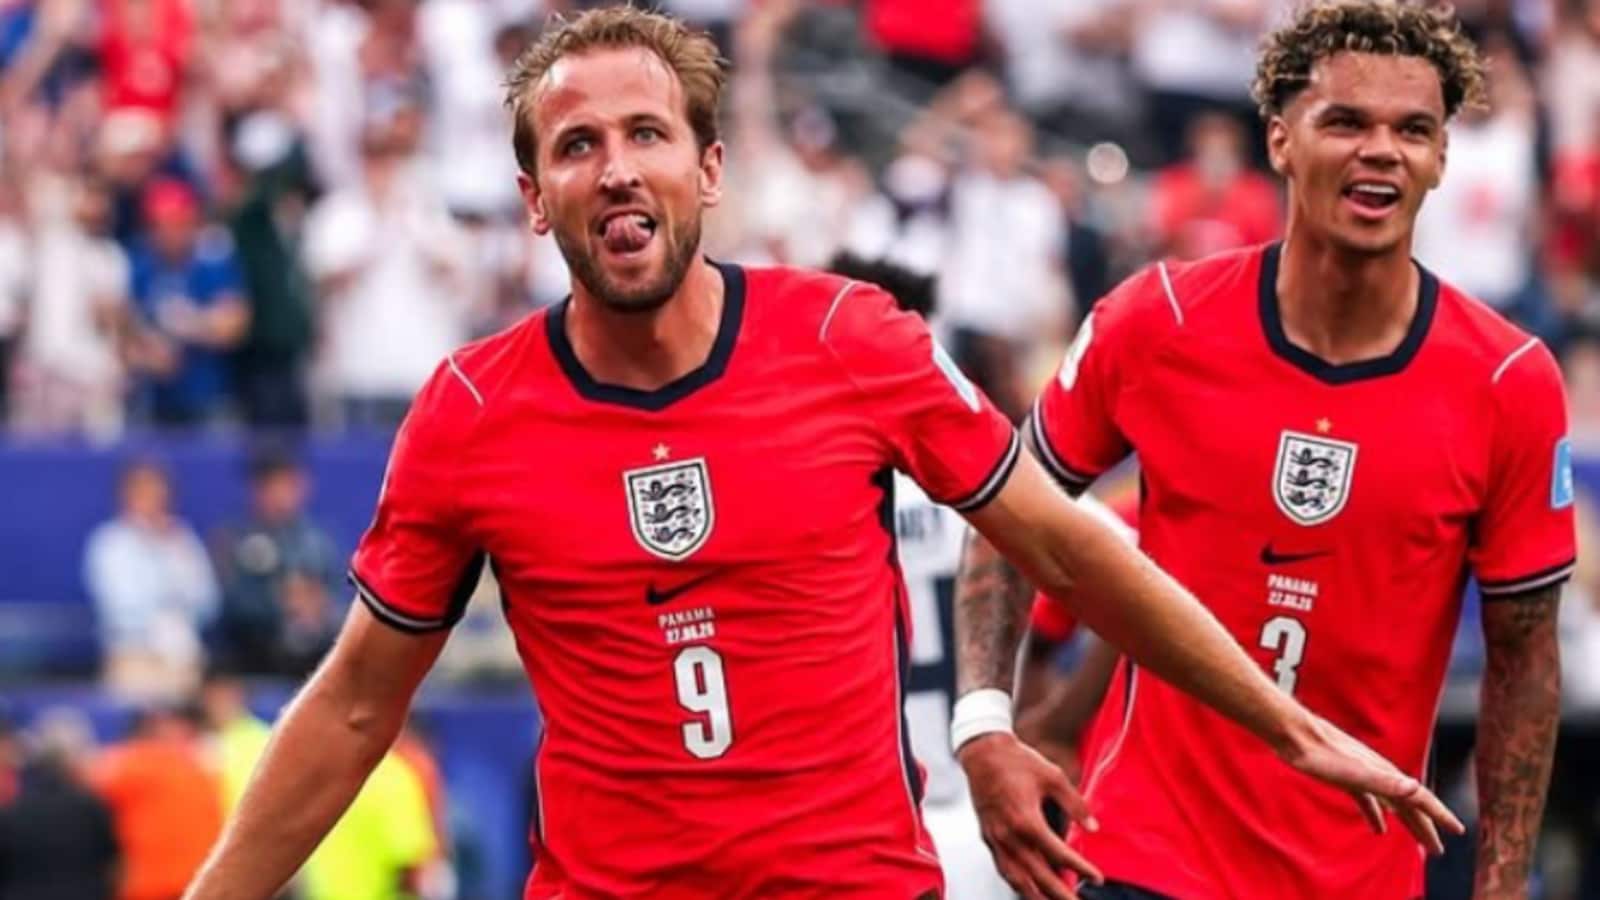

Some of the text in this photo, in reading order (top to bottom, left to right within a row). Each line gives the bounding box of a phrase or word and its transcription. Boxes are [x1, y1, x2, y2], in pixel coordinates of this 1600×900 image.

[1267, 573, 1318, 597] PANAMA
[658, 606, 715, 628] PANAMA
[1260, 615, 1306, 696] 3
[674, 646, 734, 759] 9
